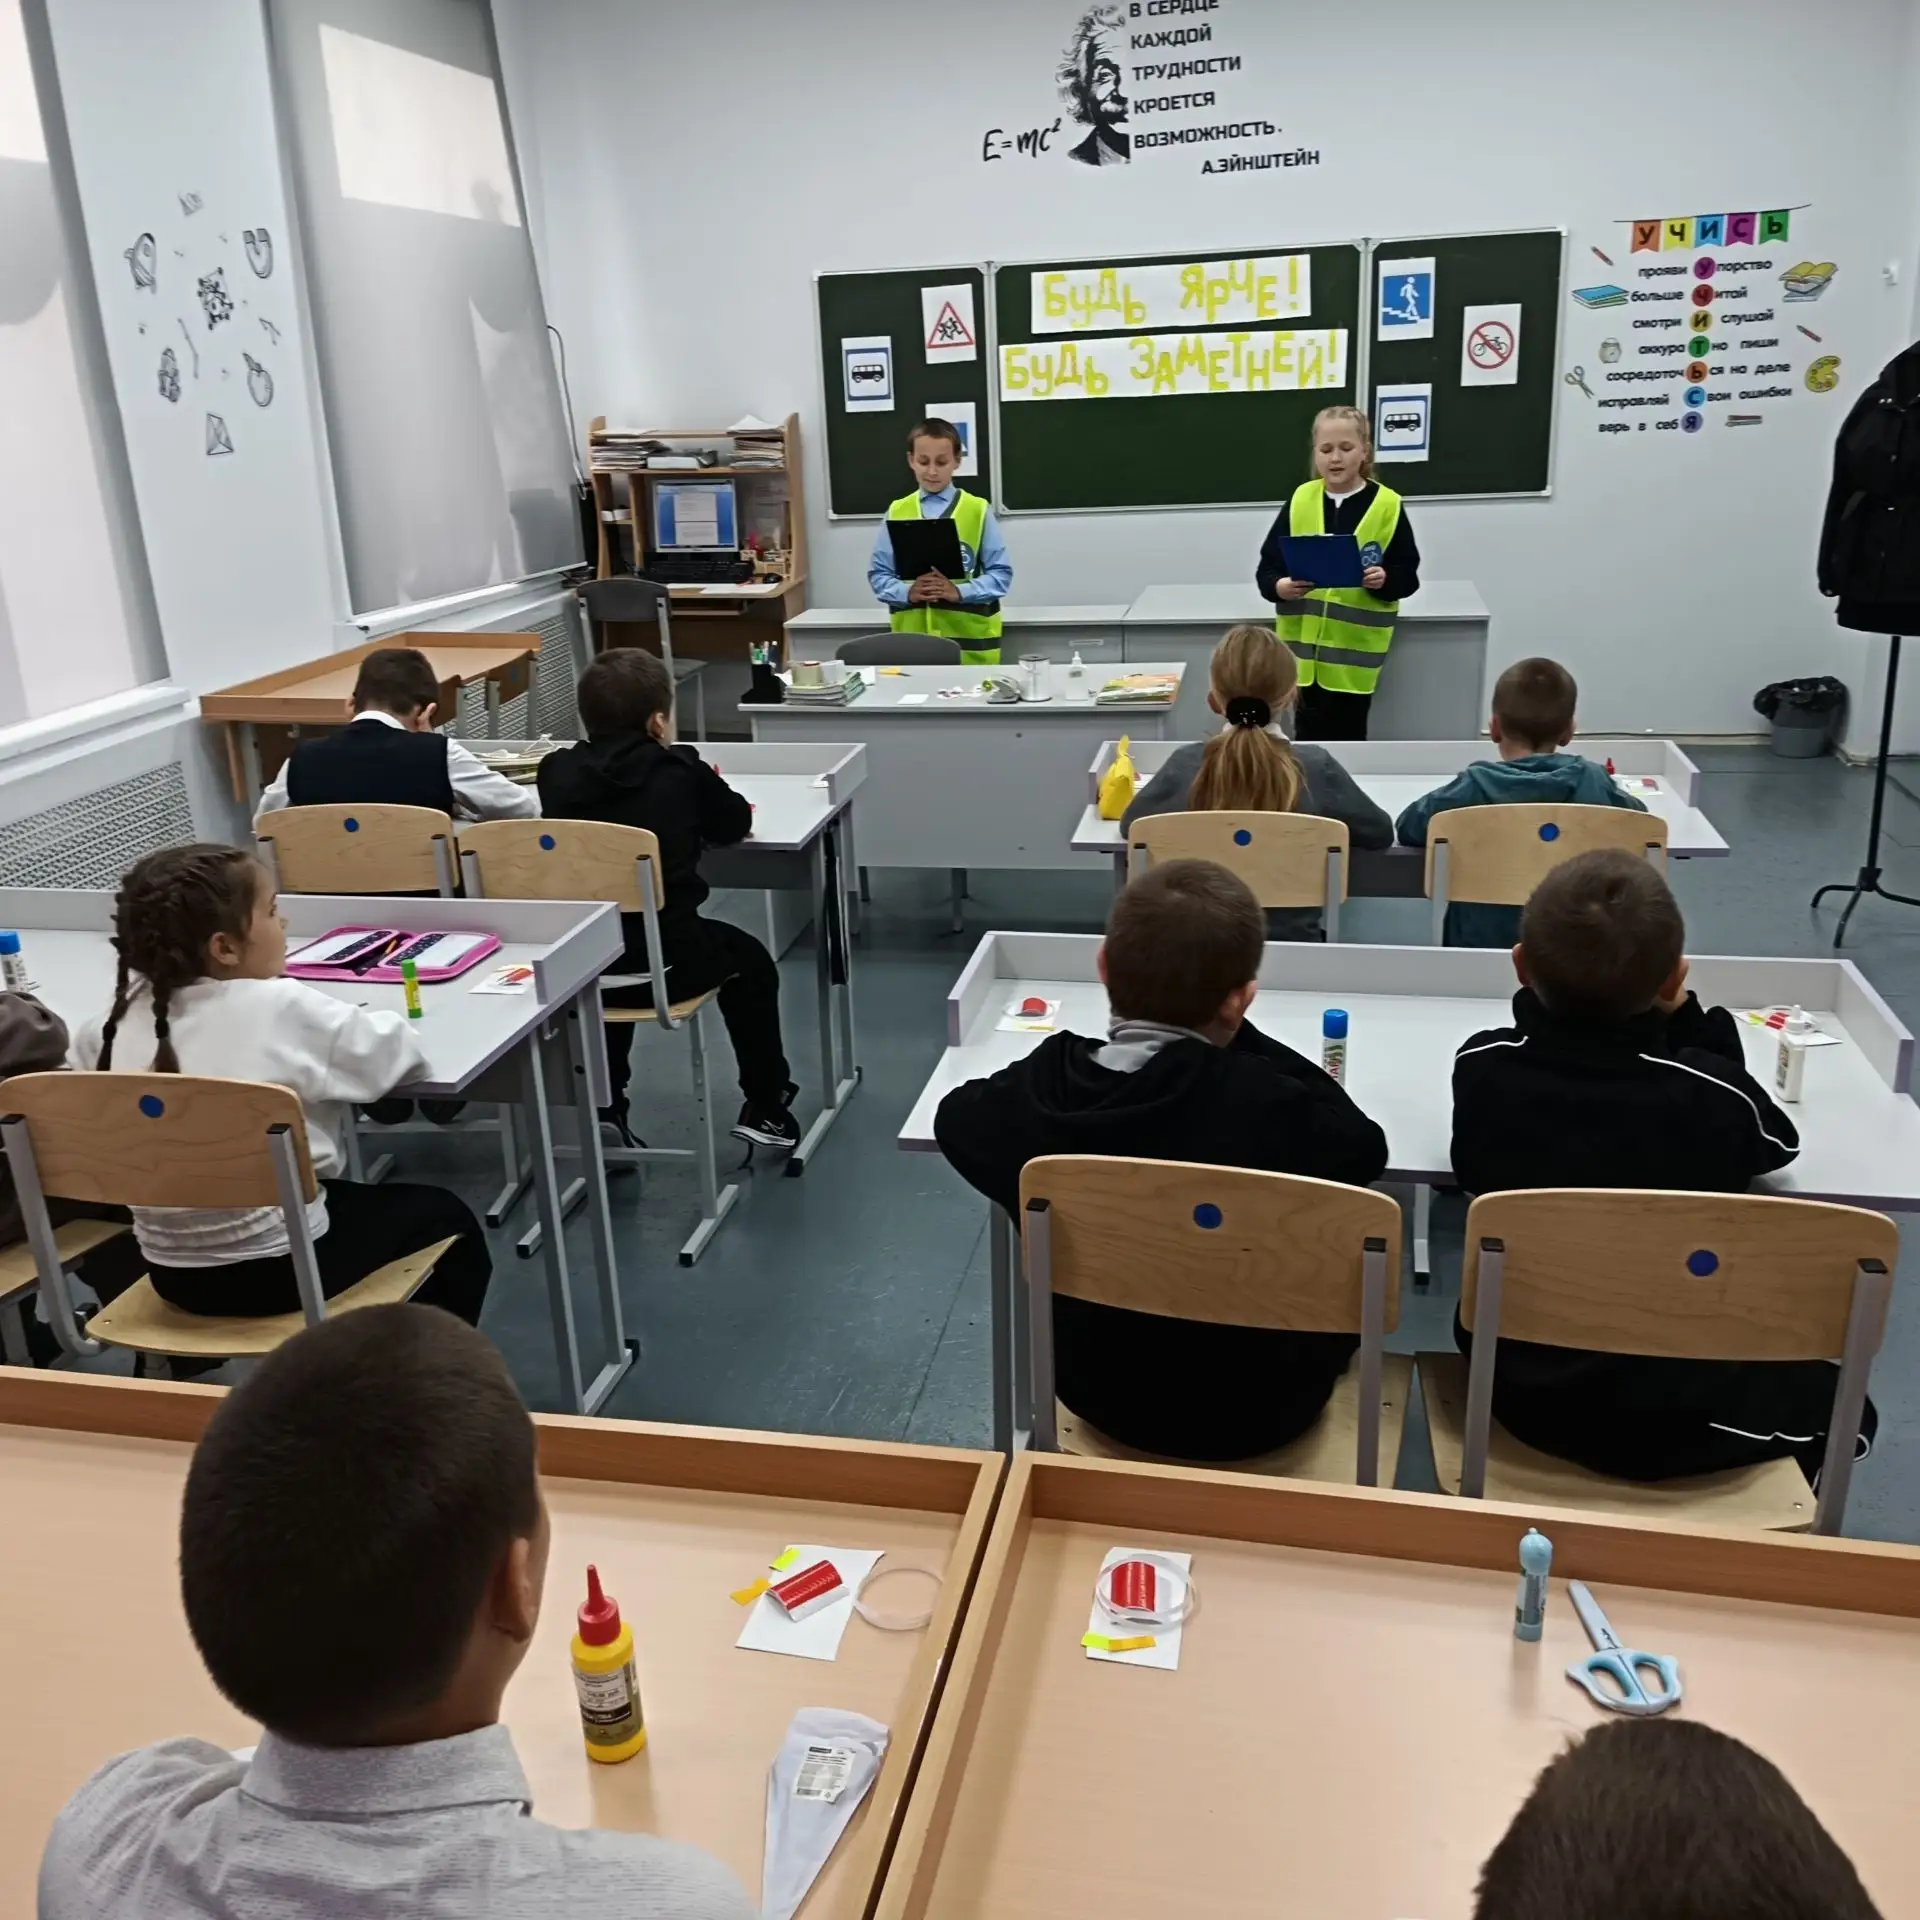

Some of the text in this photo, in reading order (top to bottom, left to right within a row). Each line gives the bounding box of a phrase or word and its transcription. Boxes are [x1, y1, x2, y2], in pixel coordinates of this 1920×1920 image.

[1129, 0, 1220, 18] В СЕРДЦЕ
[1131, 23, 1212, 50] КАЖДОЙ
[1132, 56, 1242, 82] ТРУДНОСТИ
[1134, 91, 1216, 115] КРОЕТСЯ
[1134, 121, 1283, 149] ВОЗМОЖНОСТЬ.
[1201, 148, 1320, 175] А.ЭЙНШТЕЙН
[1638, 214, 1784, 245] УЧИСЬ
[1638, 265, 1688, 279] прояви
[1180, 256, 1298, 323] ЯРЧЕ!
[1631, 290, 1684, 302] больше
[1632, 316, 1682, 330] смотри
[1721, 309, 1774, 326] слушай
[1740, 337, 1779, 349] пиши
[1129, 330, 1337, 393] ЗАМЕТНЕЙ!
[1730, 364, 1747, 375] на
[1755, 362, 1791, 375] деле
[1598, 394, 1670, 410] исправляй
[1739, 386, 1793, 400] ошибки
[1598, 421, 1631, 435] верь
[1638, 421, 1646, 432] в
